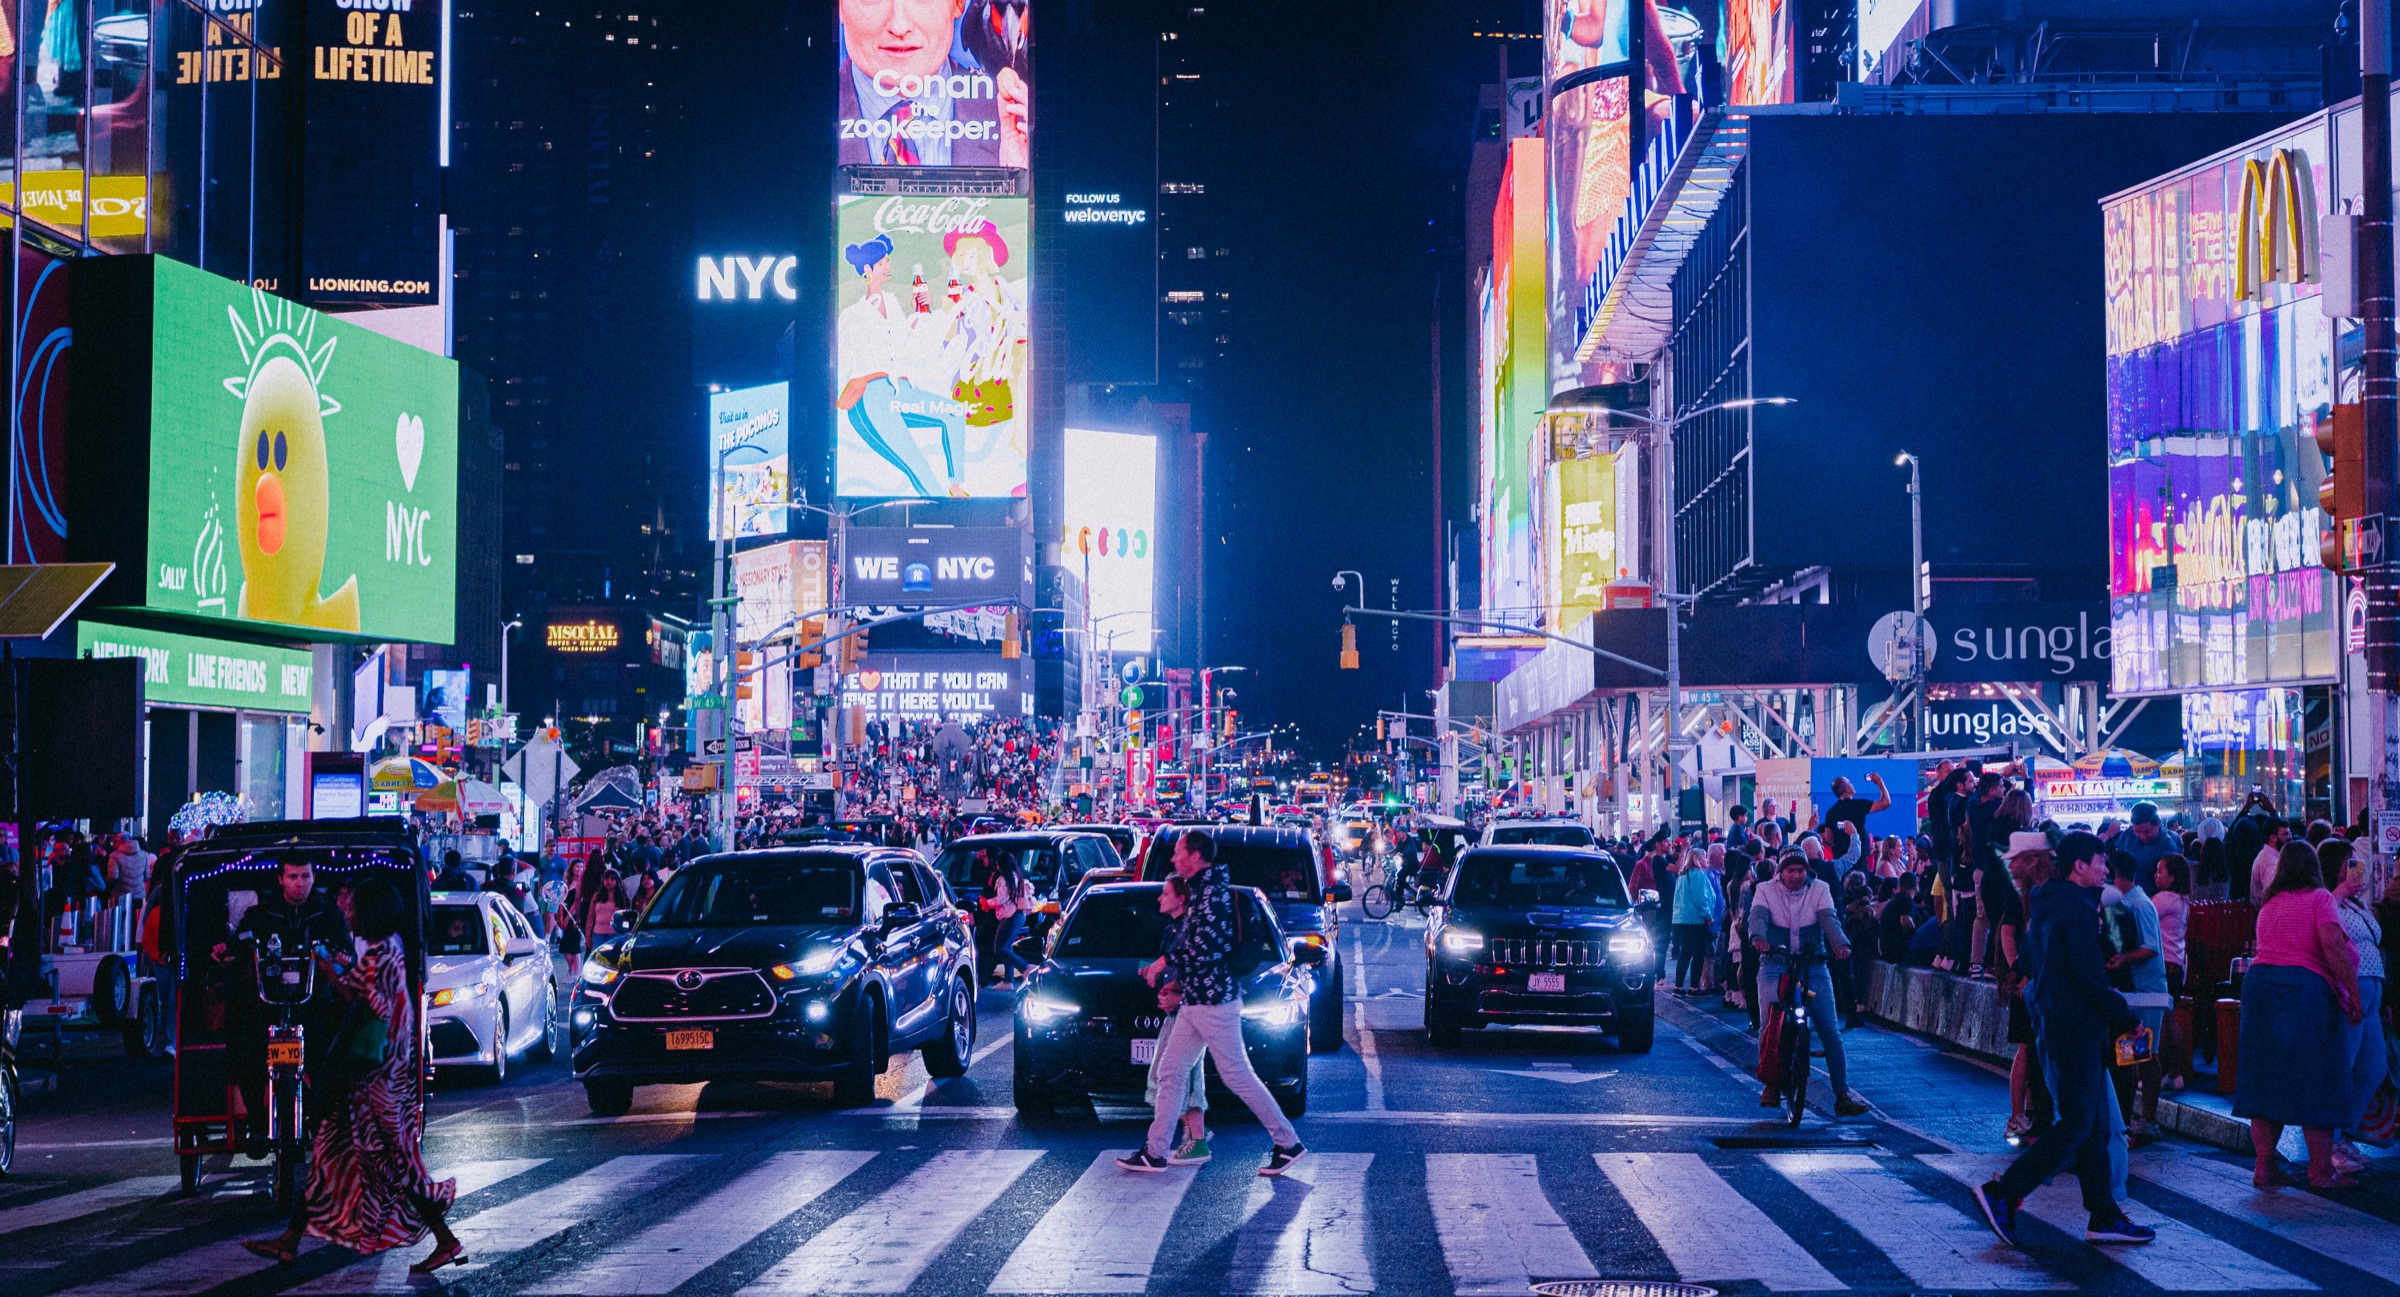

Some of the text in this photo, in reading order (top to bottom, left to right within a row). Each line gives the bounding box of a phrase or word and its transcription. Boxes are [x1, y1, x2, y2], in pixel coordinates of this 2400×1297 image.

[347, 11, 403, 47] OF A
[315, 46, 434, 84] LIFETIME
[872, 69, 994, 99] Conan
[910, 101, 940, 117] the
[840, 115, 999, 147] zookeeper.
[1066, 194, 1120, 203] FOLLOW US
[873, 196, 991, 235] Coca-Cola
[1065, 208, 1146, 225] welovenyc
[309, 277, 430, 294] LIONKING.COM
[698, 256, 797, 300] NYC
[889, 400, 925, 415] Real
[719, 410, 733, 425] Visit
[719, 407, 780, 451] THE POCONOS
[386, 500, 431, 566] NYC
[158, 563, 187, 590] SALLY
[854, 556, 995, 580] WE NYC
[188, 653, 216, 689] LINE
[217, 656, 267, 694] FRIENDS
[281, 664, 310, 697] NEW
[881, 672, 920, 690] THAT
[923, 672, 939, 690] IF
[942, 672, 971, 690] YOU
[976, 672, 1008, 690] CAN
[694, 698, 701, 708] W
[705, 698, 714, 708] 45
[900, 692, 939, 710] HERE
[942, 692, 995, 710] YOU'LL
[1690, 693, 1698, 703] W
[1701, 693, 1711, 702] 45
[2309, 729, 2330, 748] NO
[2037, 771, 2073, 779] SABRETT
[1544, 977, 1560, 987] 5555
[1135, 1045, 1155, 1059] T111
